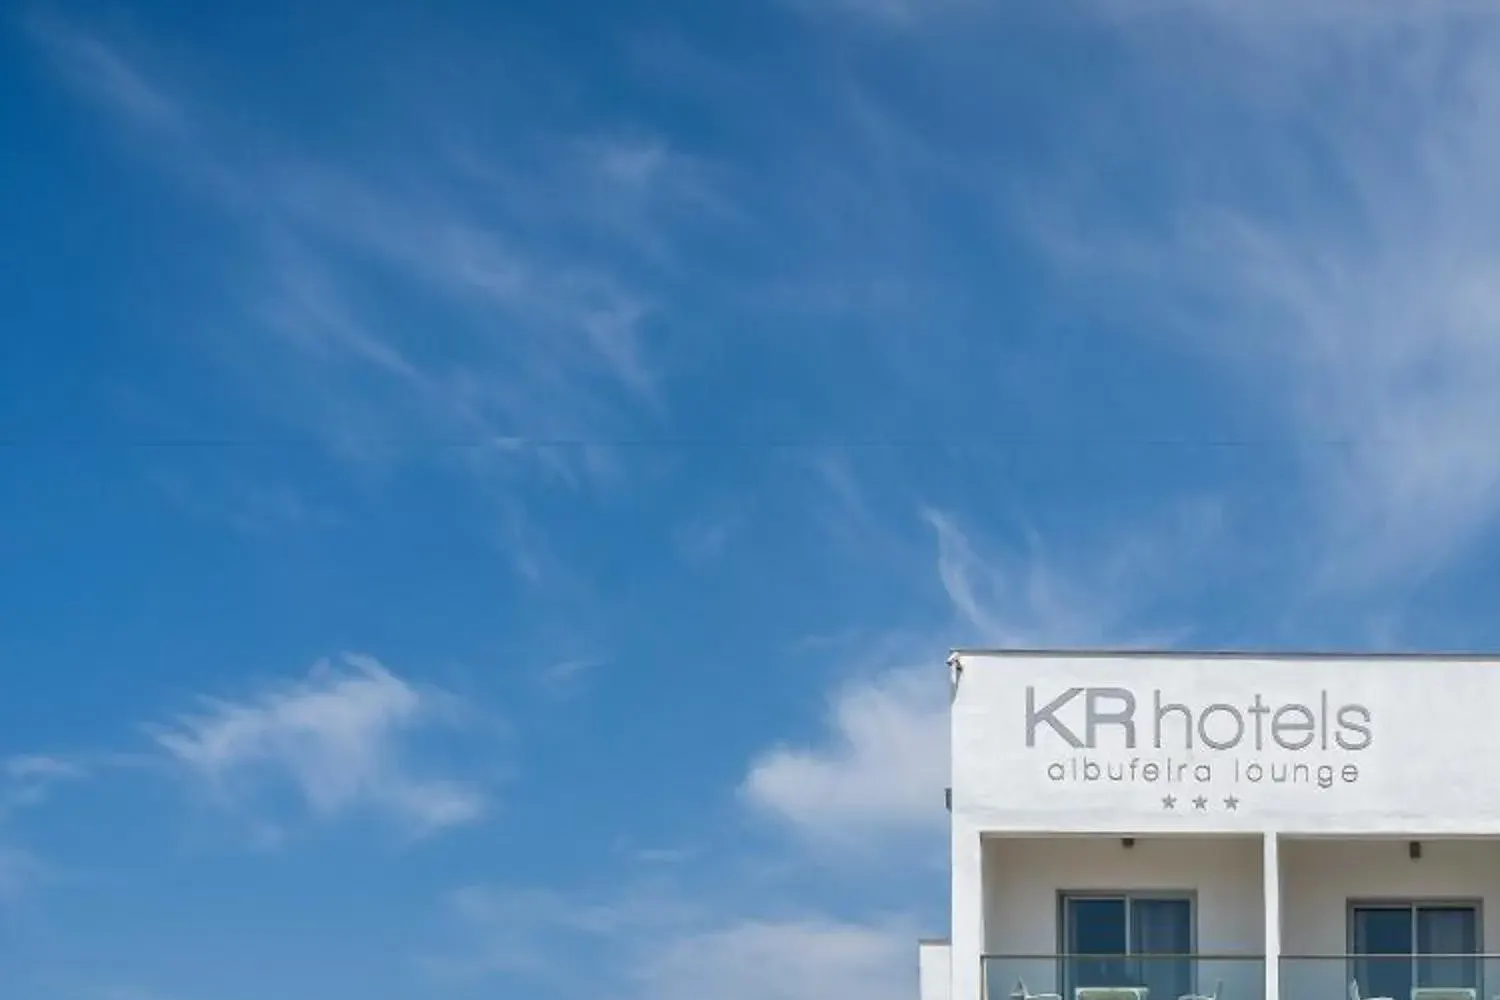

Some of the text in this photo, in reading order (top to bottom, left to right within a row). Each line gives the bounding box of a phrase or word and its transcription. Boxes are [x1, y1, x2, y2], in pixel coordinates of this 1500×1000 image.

[1153, 689, 1373, 751] hotels
[1047, 757, 1359, 789] albufeira lounge
